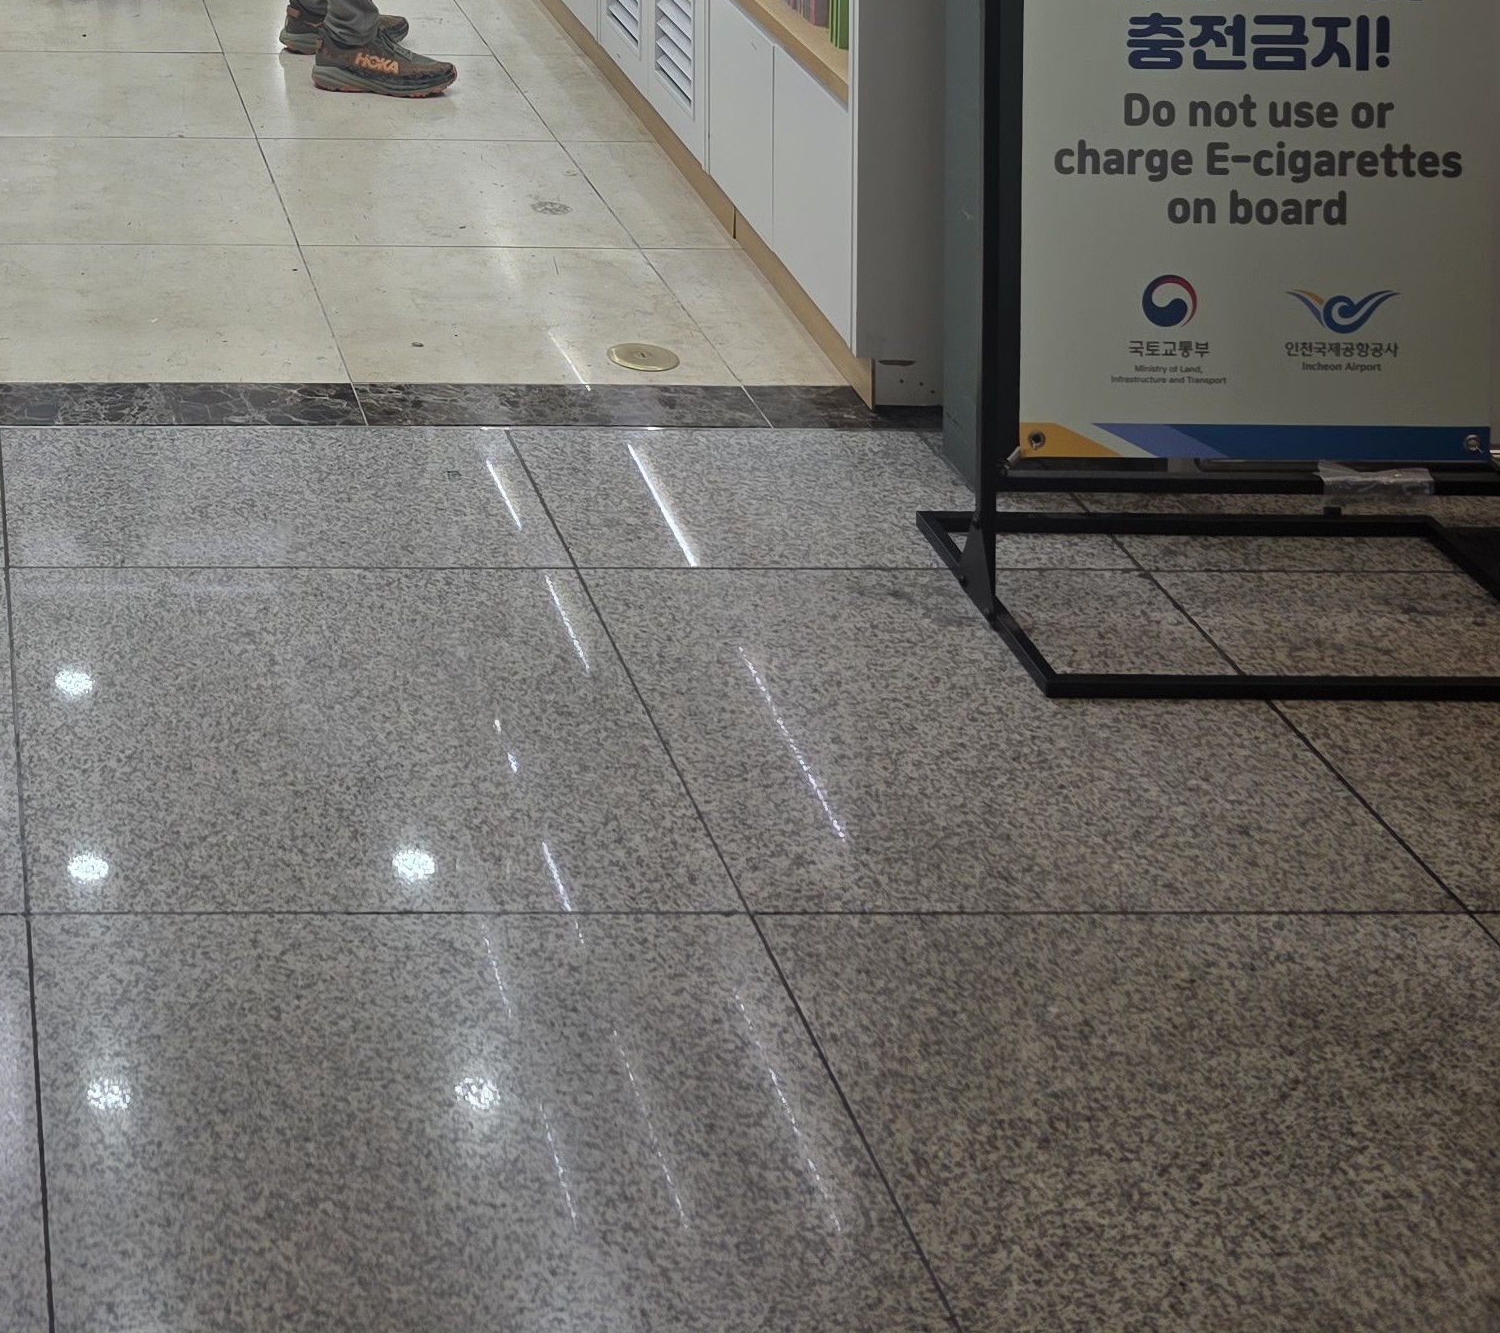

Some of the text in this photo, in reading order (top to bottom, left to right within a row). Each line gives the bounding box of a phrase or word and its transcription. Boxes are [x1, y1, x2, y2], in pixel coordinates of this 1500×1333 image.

[1127, 13, 1390, 71] 충전금지!
[355, 52, 399, 74] HOKA
[1124, 93, 1394, 129] Do not use or
[1055, 140, 1462, 183] charge E-cigarettes
[1168, 190, 1346, 225] on board
[1128, 340, 1211, 359] 국토교통부
[1284, 341, 1400, 359] 인천국제공항공사
[1301, 361, 1382, 374] Incheon Airport
